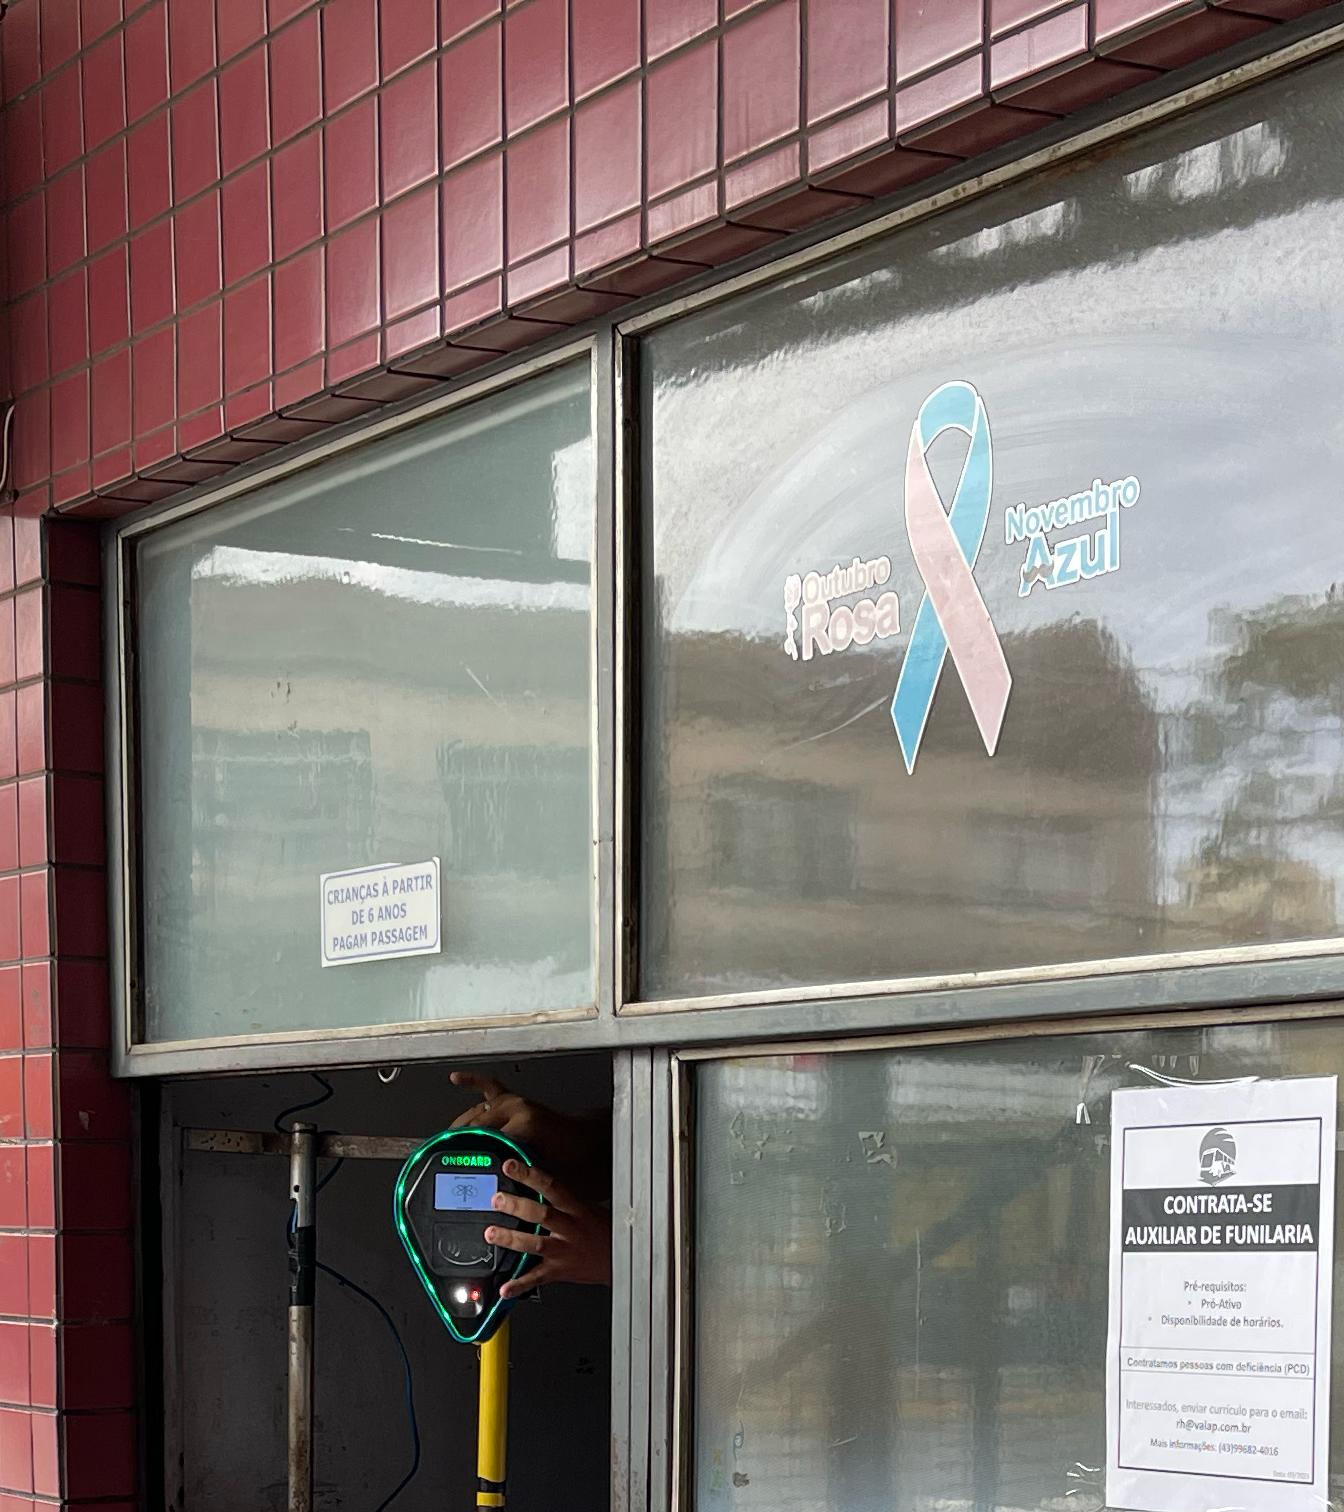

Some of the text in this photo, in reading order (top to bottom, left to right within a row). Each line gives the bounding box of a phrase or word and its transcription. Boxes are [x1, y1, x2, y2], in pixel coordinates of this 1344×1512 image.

[1006, 477, 1140, 544] Novembro
[1019, 510, 1119, 596] Azul
[802, 556, 891, 604] Outubro
[802, 592, 900, 660] Rosa
[327, 882, 379, 905] CRIANÇAS
[392, 874, 433, 895] PARTIR
[351, 903, 407, 926] DE 6 ANOS
[332, 924, 428, 952] PAGAM PASSAGEM
[441, 1155, 492, 1167] ONBOARD
[1163, 1193, 1273, 1214] CONTRATA-SE
[1125, 1224, 1314, 1245] AUXILIAR DE FUNILARIA
[1161, 1315, 1228, 1327] Disponibilidade
[1230, 1316, 1241, 1327] de
[1127, 1357, 1178, 1369] Contratamos
[1179, 1361, 1214, 1371] pessoas
[1215, 1363, 1234, 1371] com
[1284, 1363, 1310, 1376] (PCD)
[1181, 1404, 1207, 1413] enviar
[1249, 1408, 1269, 1419] para
[1271, 1410, 1278, 1418] o
